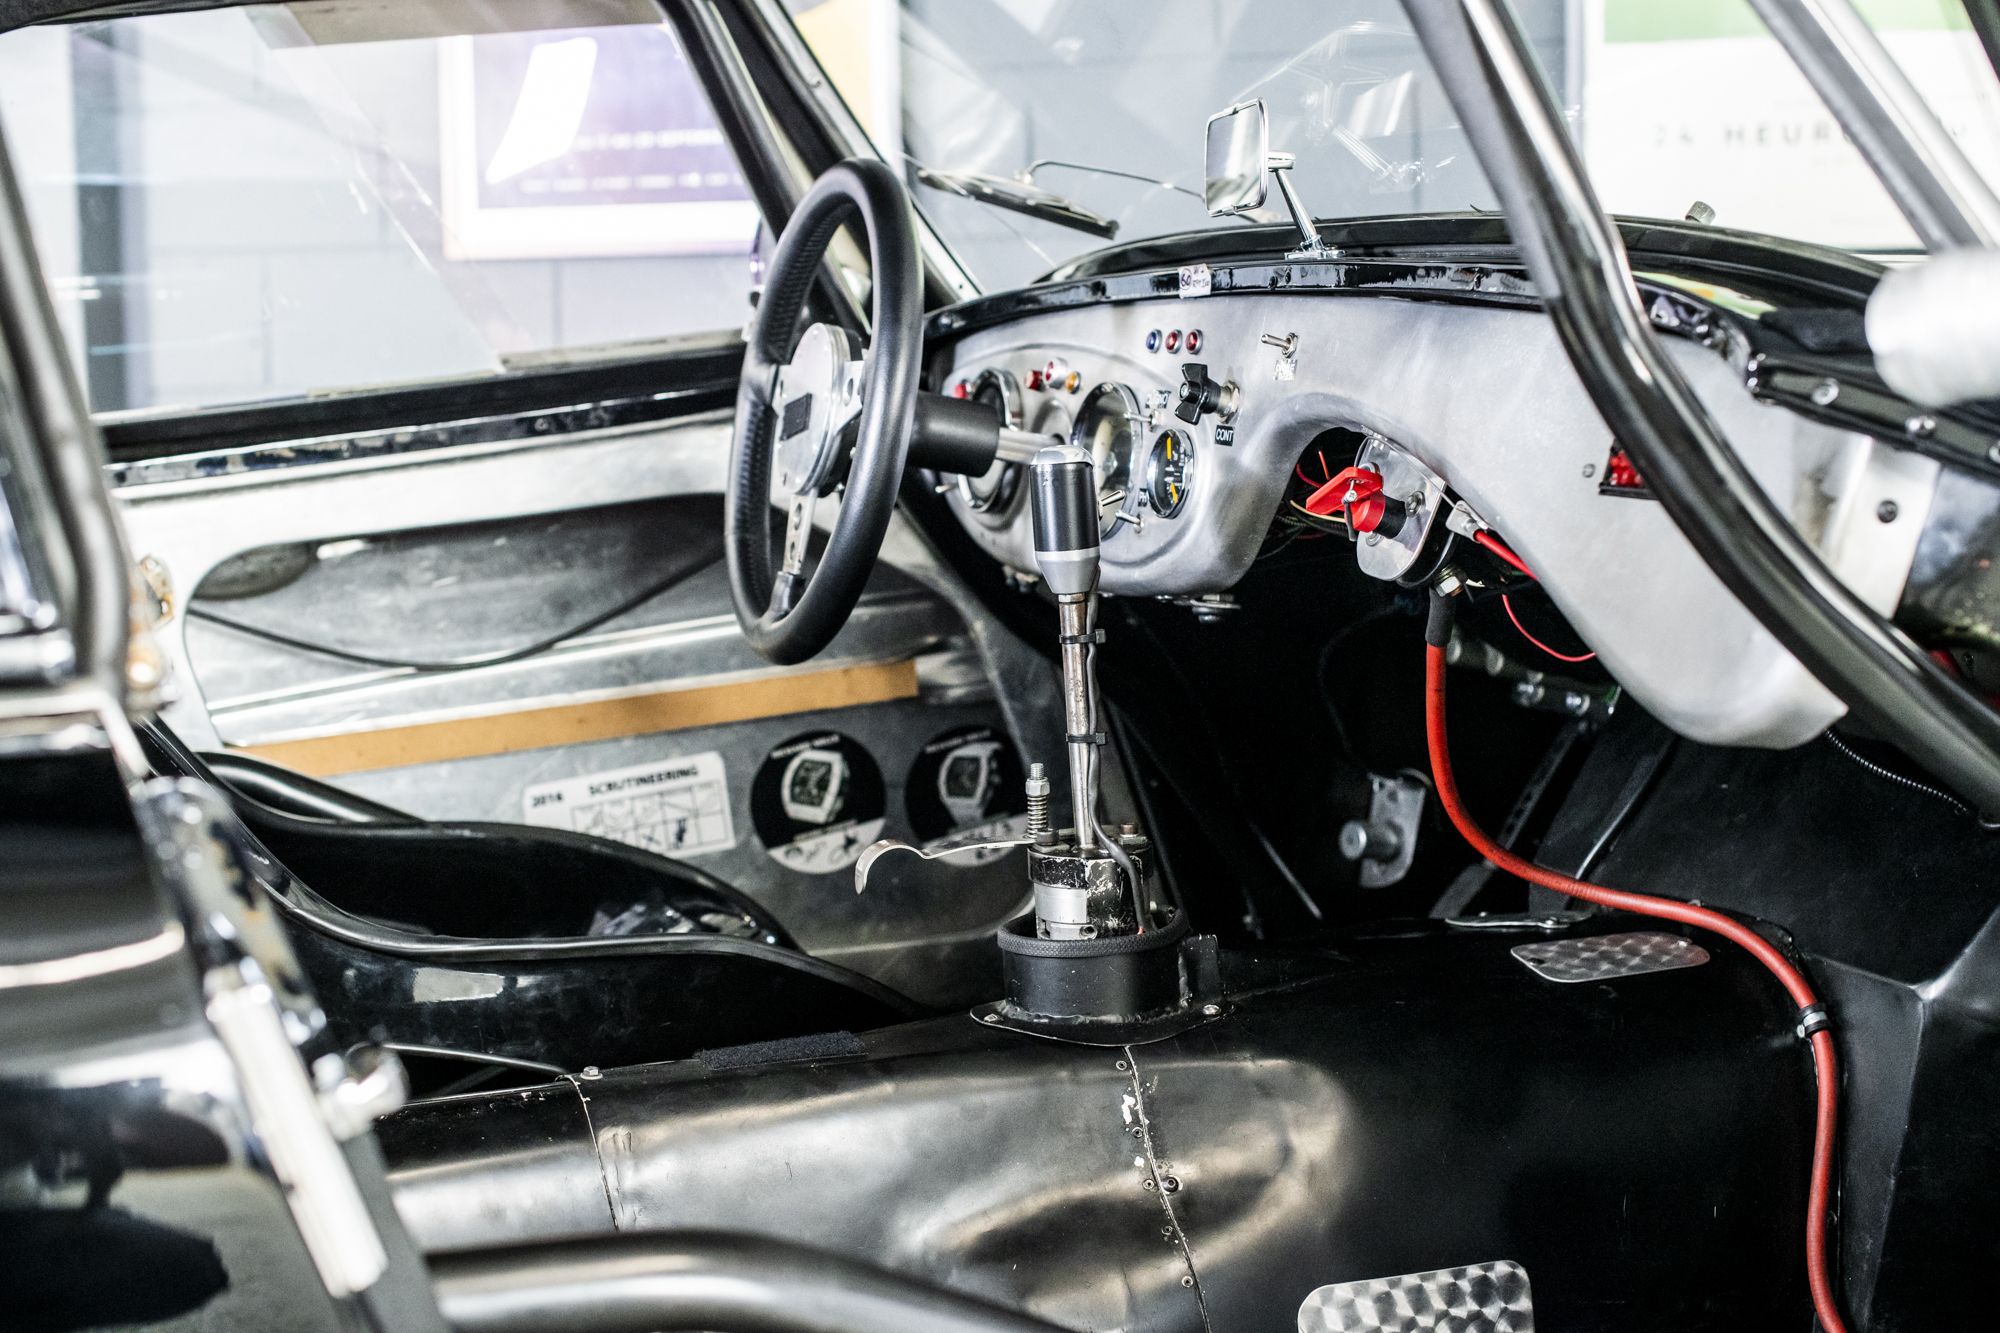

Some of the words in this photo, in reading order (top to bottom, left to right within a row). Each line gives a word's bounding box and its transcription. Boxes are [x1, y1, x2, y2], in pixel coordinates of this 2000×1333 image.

[1724, 121, 1841, 147] HEUR
[1215, 428, 1234, 442] CONT
[588, 764, 699, 796] SCRUTINEERING
